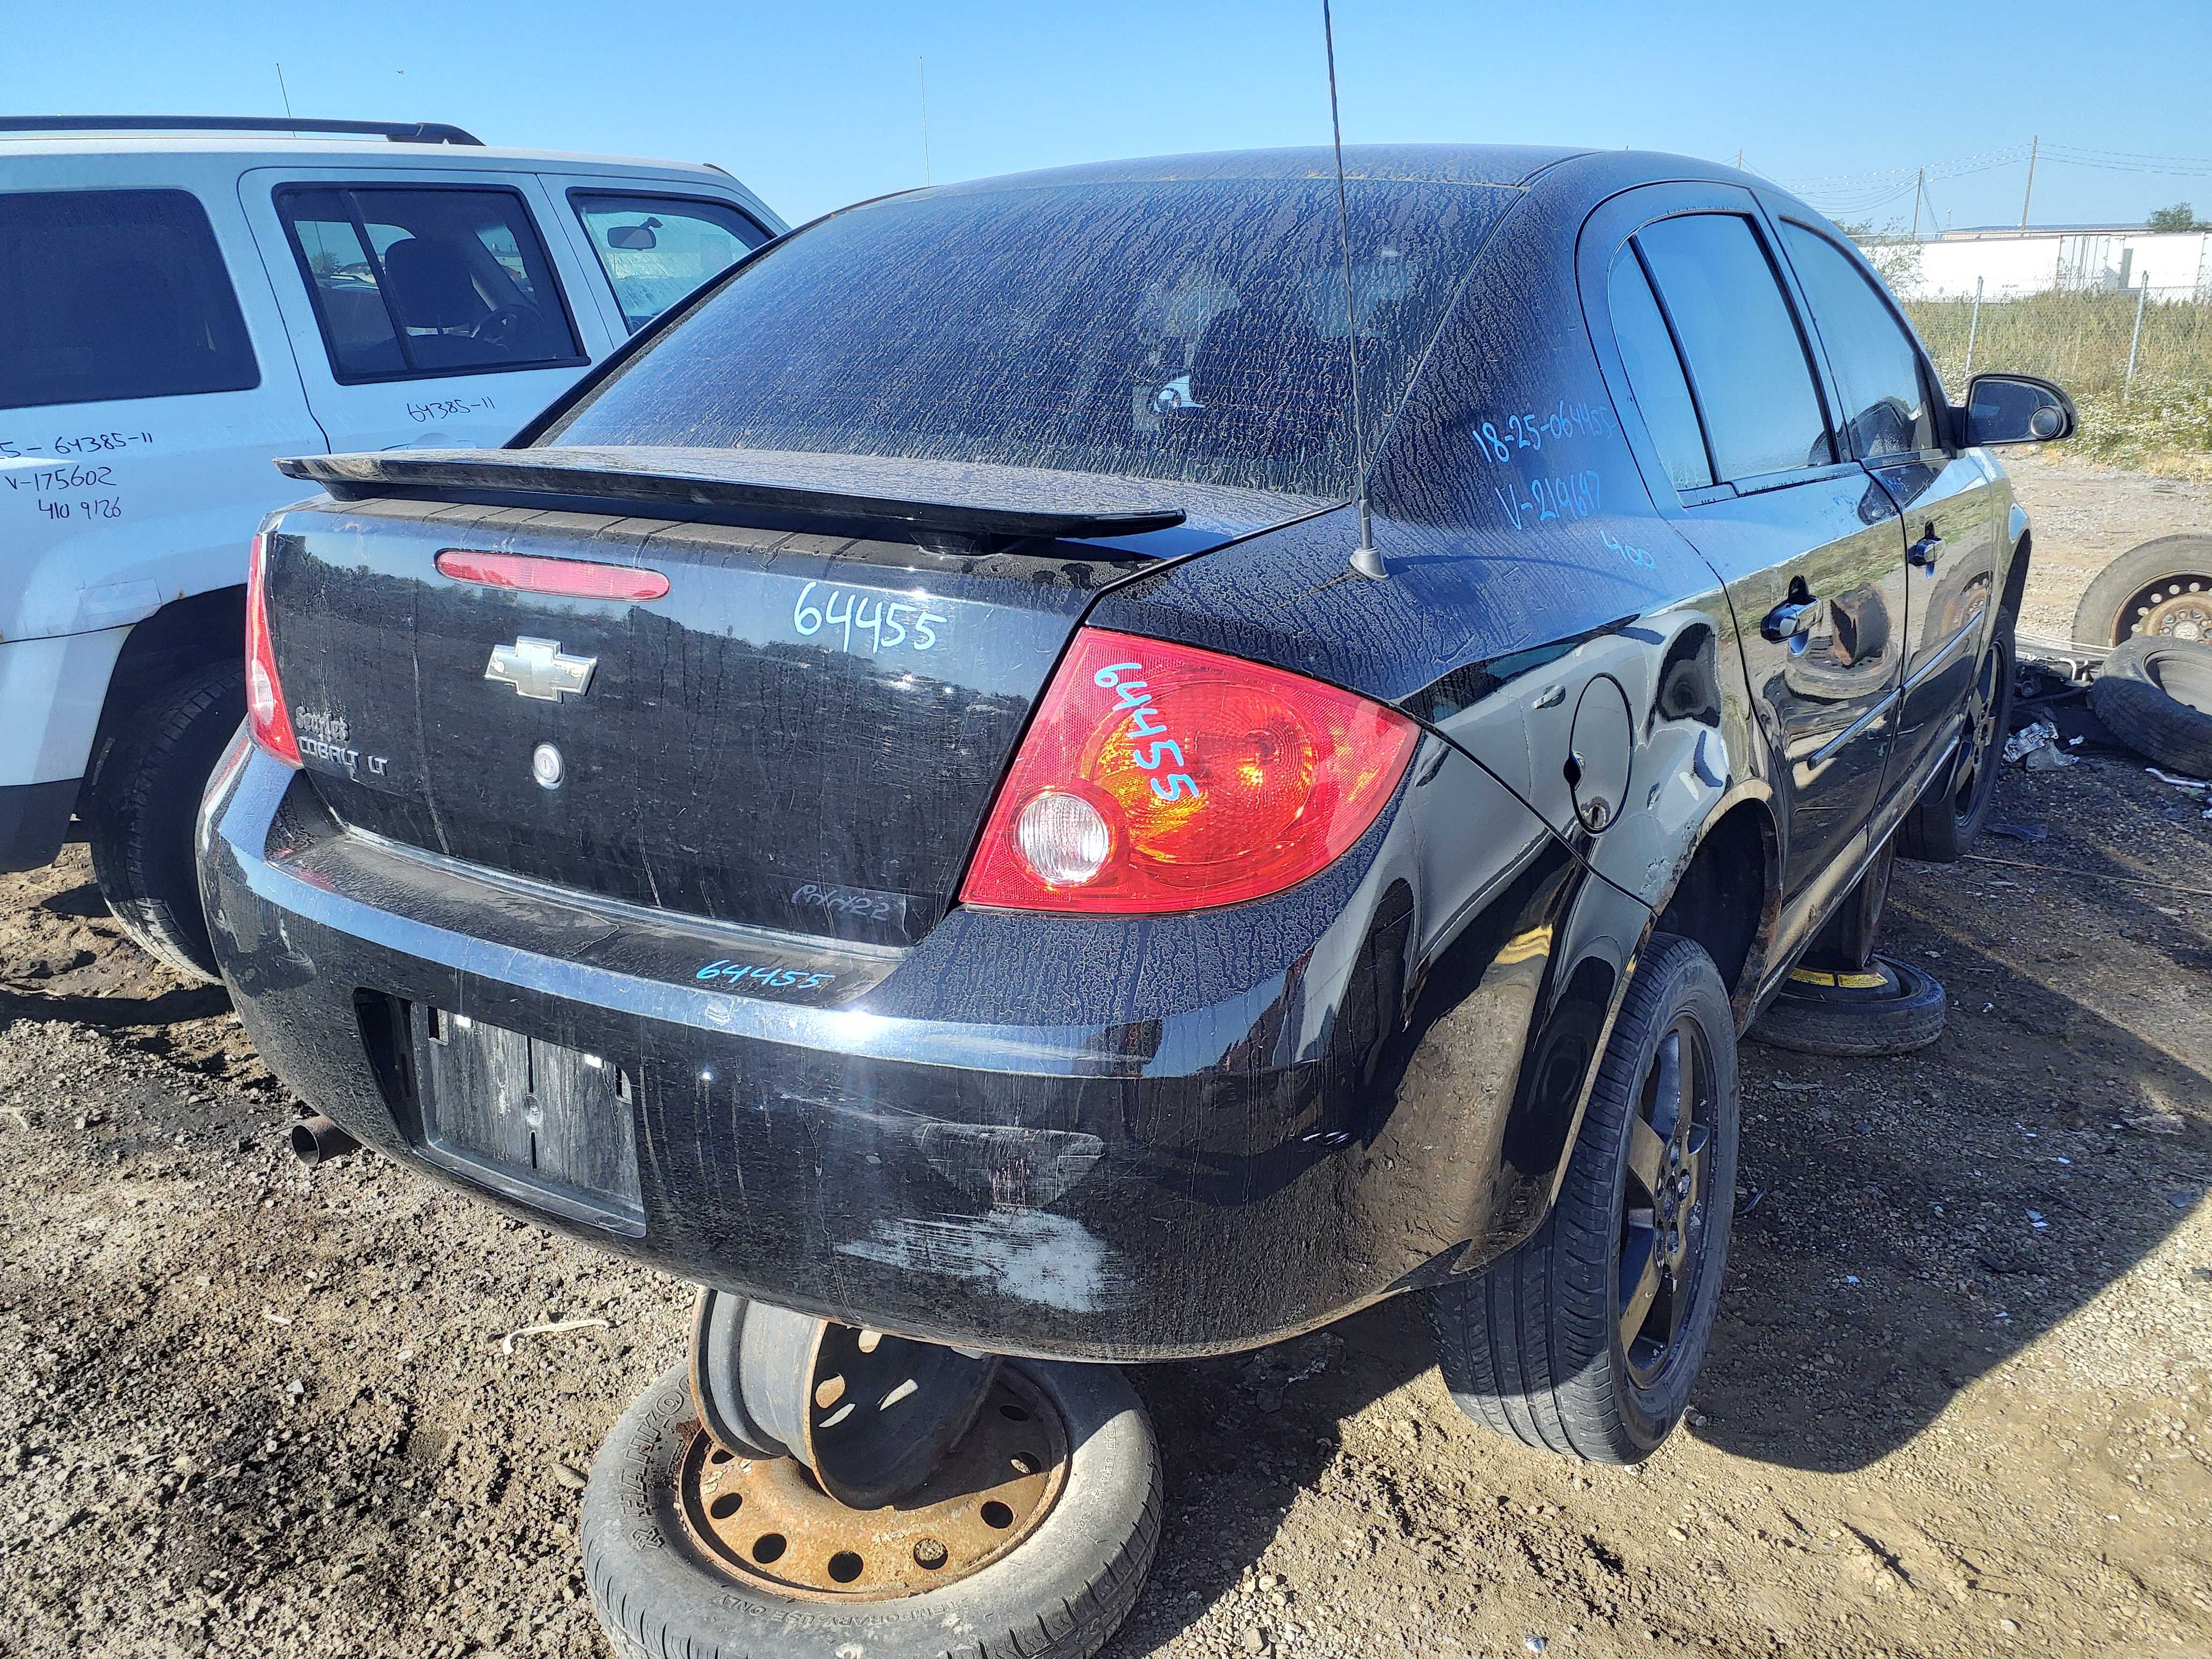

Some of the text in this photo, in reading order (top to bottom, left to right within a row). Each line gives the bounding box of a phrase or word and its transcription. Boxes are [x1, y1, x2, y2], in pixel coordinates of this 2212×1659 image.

[407, 397, 495, 422] 64385-11
[5, 465, 117, 491] V-175602
[38, 496, 121, 519] 410 9126
[794, 581, 948, 654] 64455
[1094, 662, 1199, 801] 64455
[298, 736, 389, 776] COBALT LT
[696, 959, 836, 989] 64455
[716, 1591, 962, 1627] TEMPORARY USE ONLY
